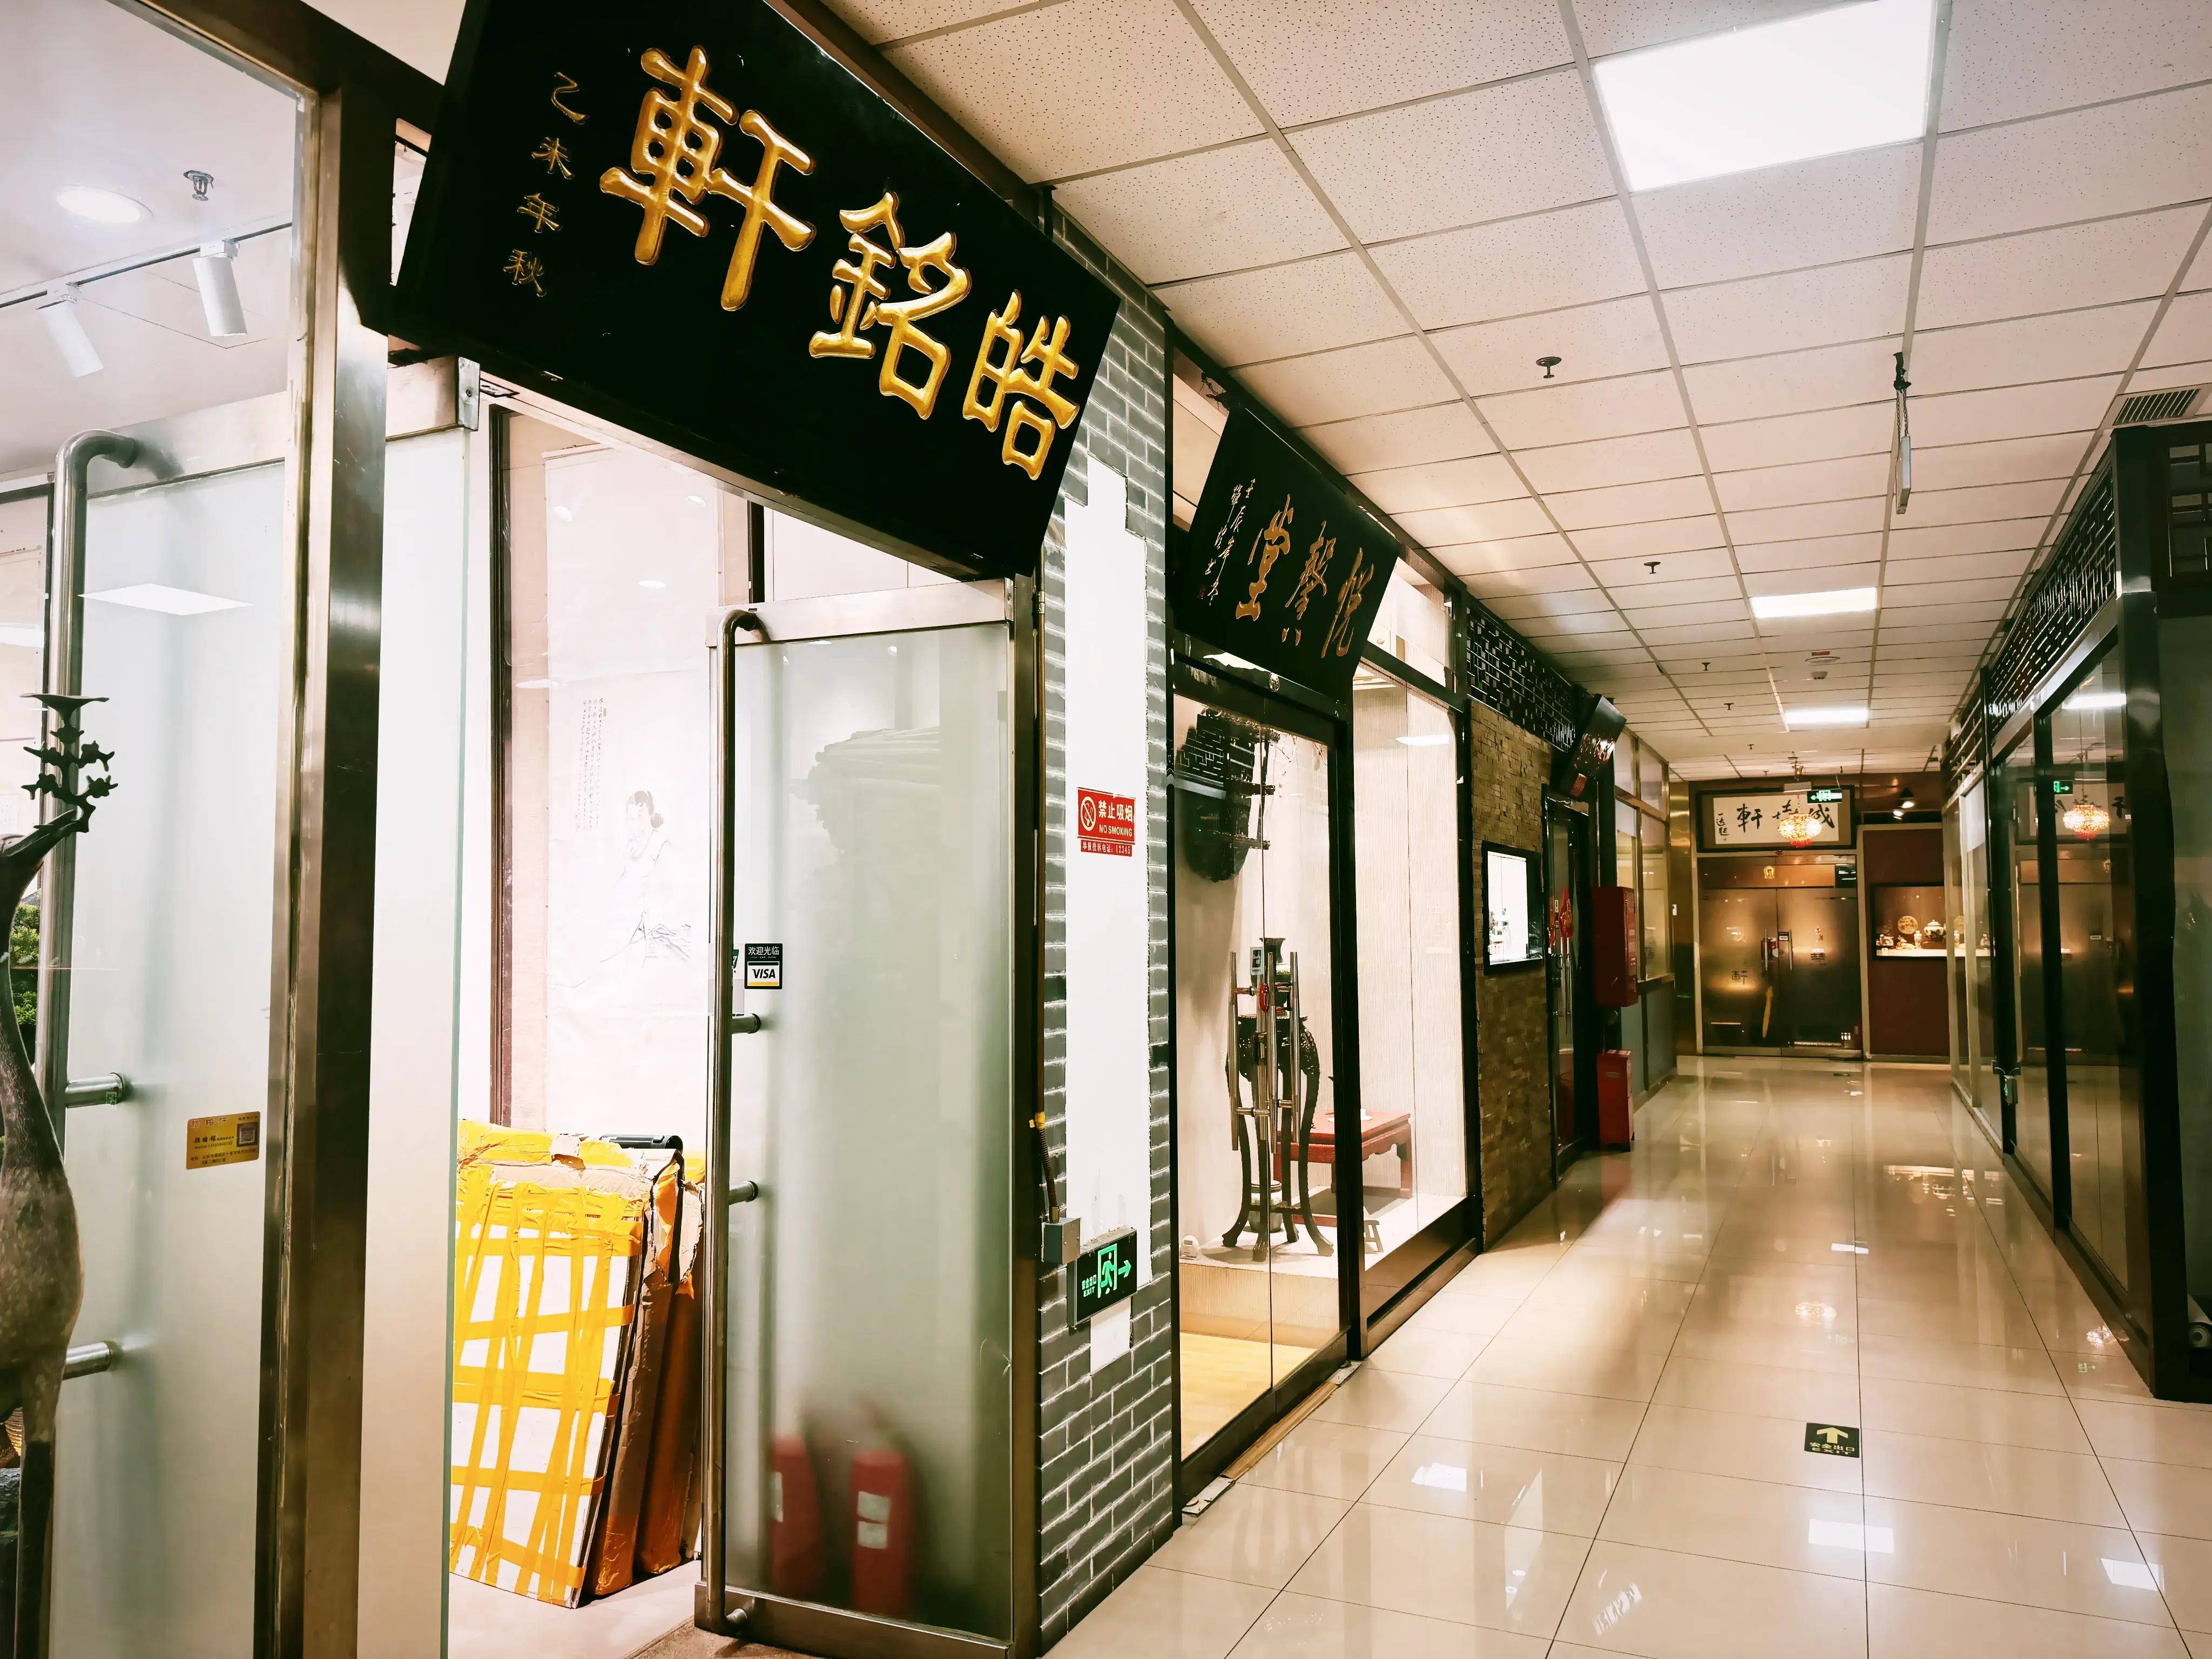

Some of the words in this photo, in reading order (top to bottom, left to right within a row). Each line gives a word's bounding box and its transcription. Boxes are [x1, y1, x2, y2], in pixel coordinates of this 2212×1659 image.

[503, 71, 590, 297] 乙未年秋
[1098, 799, 1134, 824] 禁止吸烟
[1099, 824, 1108, 834] NO
[1108, 825, 1132, 837] SMOKING
[748, 946, 779, 955] 欢迎光临
[752, 968, 776, 979] VISA
[1083, 1286, 1095, 1297] EXIT
[1809, 1442, 1854, 1452] 安全出口
[1812, 1447, 1852, 1455] EXIT
